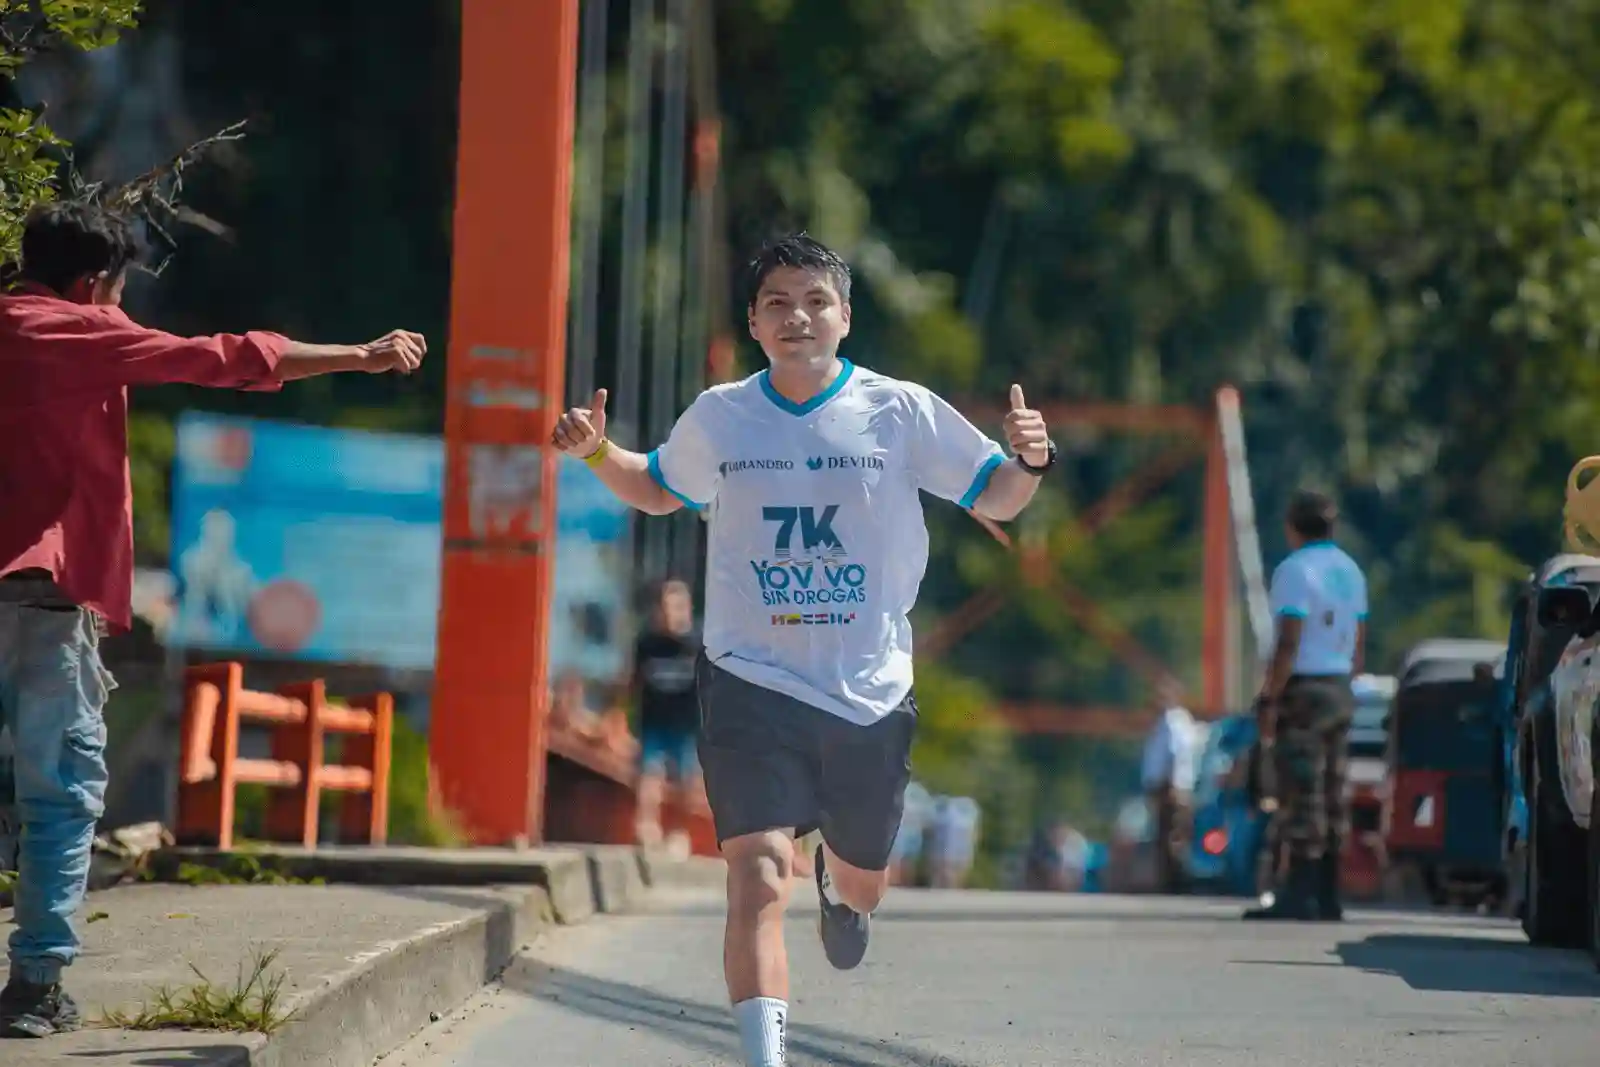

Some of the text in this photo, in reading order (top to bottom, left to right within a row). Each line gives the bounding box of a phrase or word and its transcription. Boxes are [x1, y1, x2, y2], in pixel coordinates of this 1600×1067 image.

[828, 455, 884, 471] DEVIDA
[762, 504, 847, 557] 7K
[762, 587, 866, 606] SIN DROGAS
